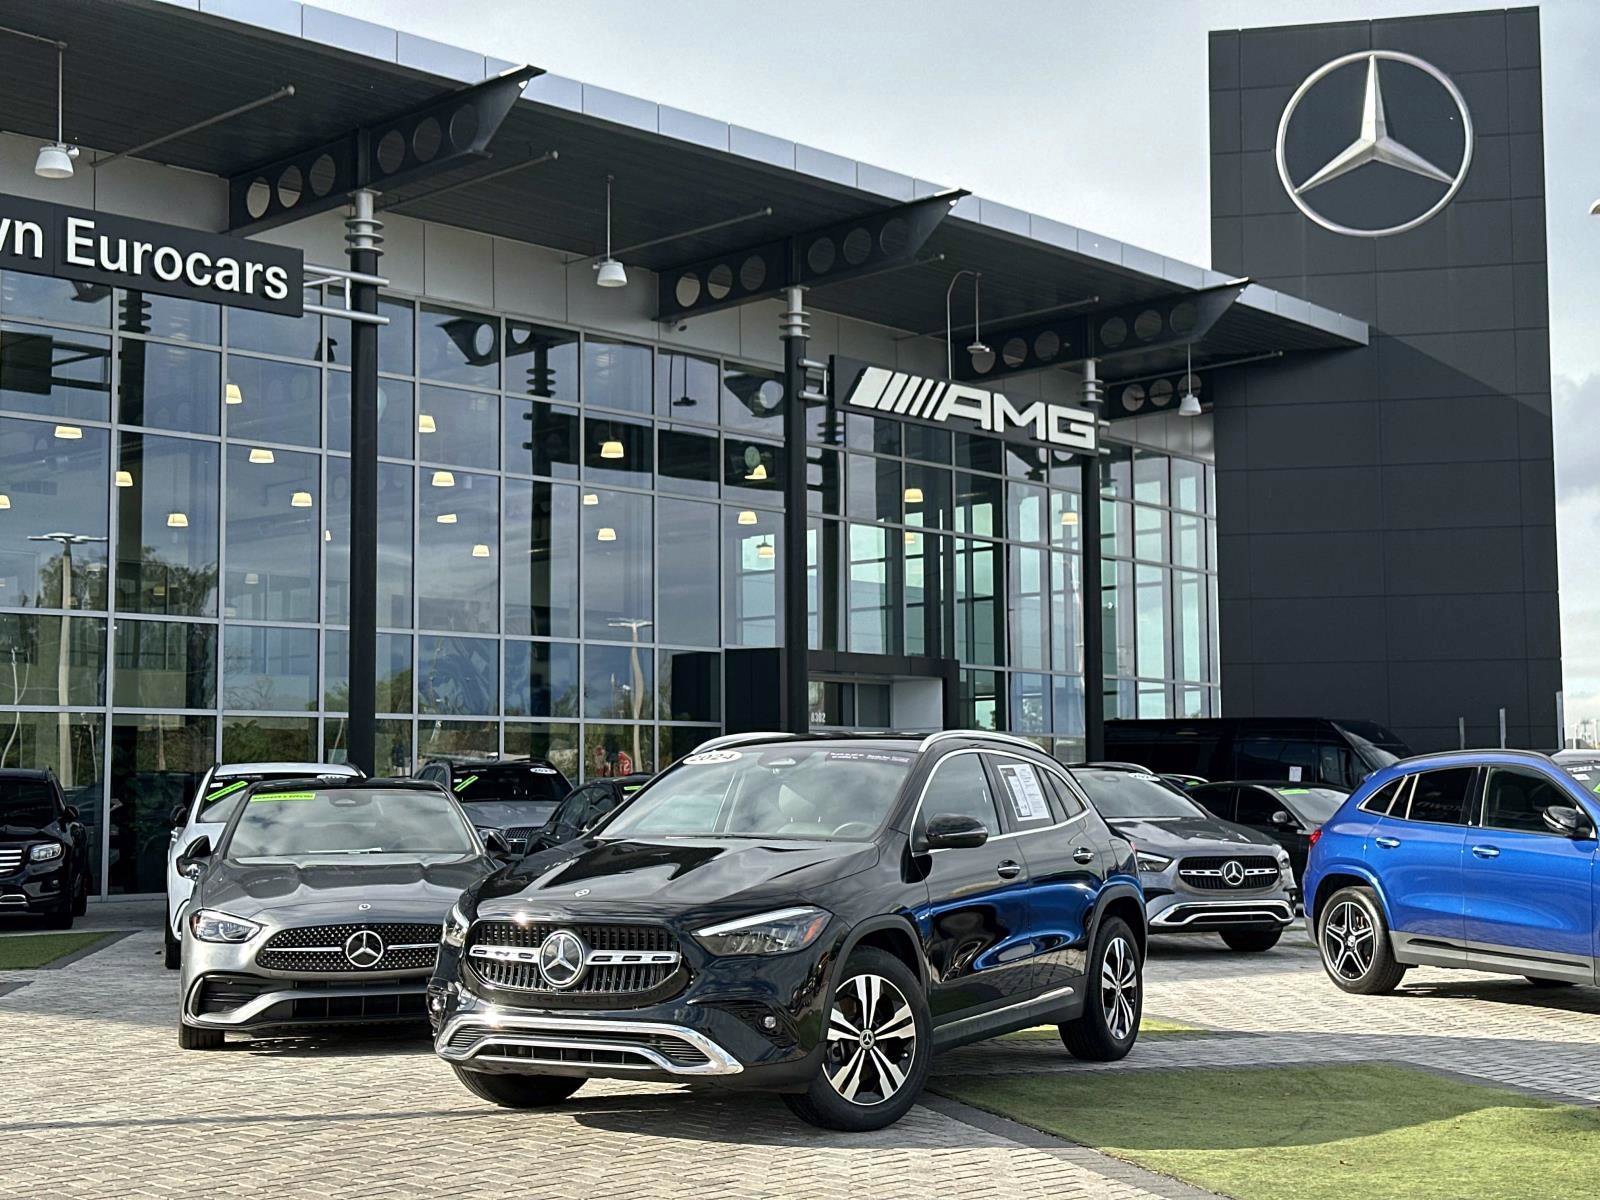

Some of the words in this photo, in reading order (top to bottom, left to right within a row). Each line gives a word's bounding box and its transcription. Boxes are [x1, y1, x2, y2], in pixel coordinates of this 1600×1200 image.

[0, 217, 43, 258] n
[66, 216, 289, 300] Eurocars
[933, 383, 1096, 450] AMG
[688, 752, 737, 762] 2024
